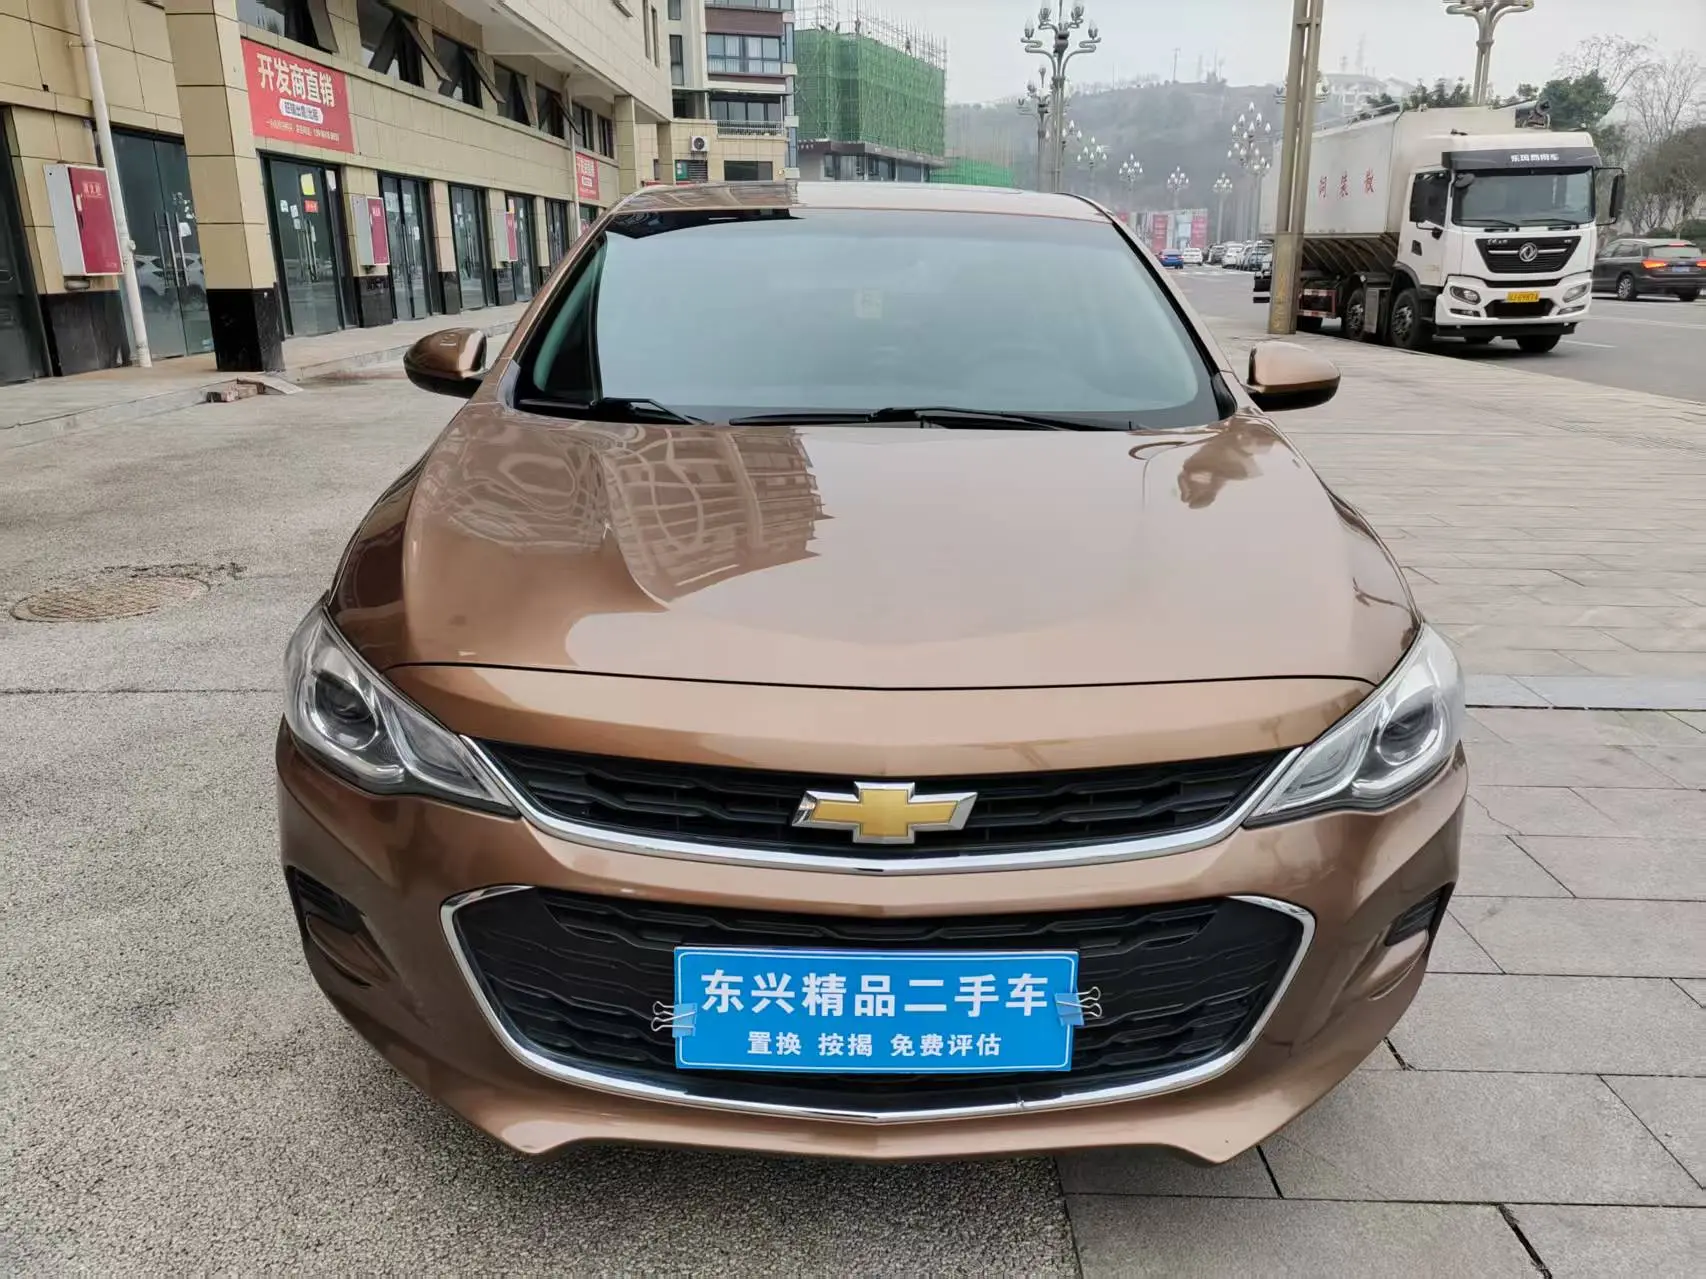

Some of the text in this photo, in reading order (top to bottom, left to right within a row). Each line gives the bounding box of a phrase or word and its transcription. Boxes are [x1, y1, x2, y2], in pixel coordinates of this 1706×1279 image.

[256, 53, 335, 107] 开发商直销
[701, 969, 1049, 1018] 东兴精品二手车
[747, 1031, 1002, 1058] 置换 按揭 免费评估
